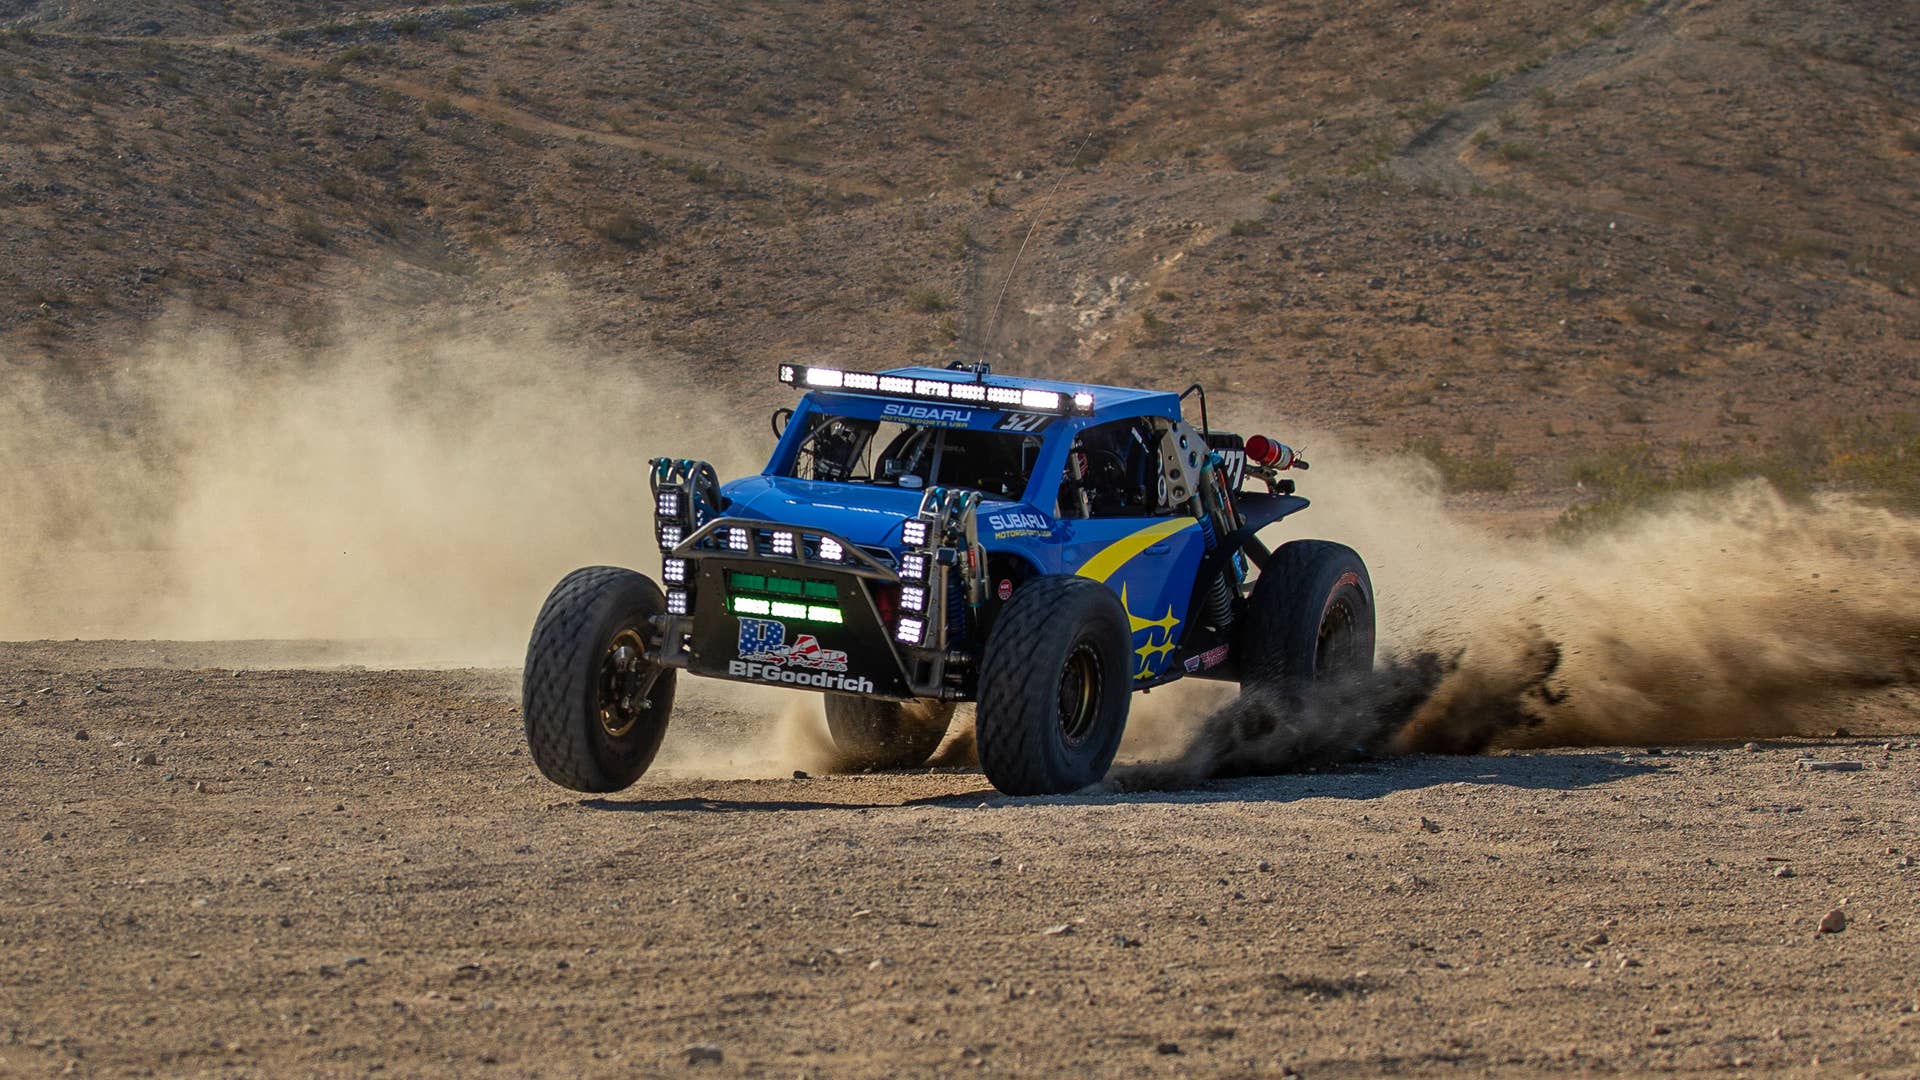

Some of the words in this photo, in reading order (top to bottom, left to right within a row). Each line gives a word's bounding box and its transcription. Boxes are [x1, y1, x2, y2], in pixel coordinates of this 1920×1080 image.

[883, 404, 972, 421] SUBARU
[880, 415, 947, 427] MOTORSPORTS
[949, 421, 968, 429] USA
[989, 513, 1049, 530] SUBARU
[729, 660, 874, 694] BFGoodrich
